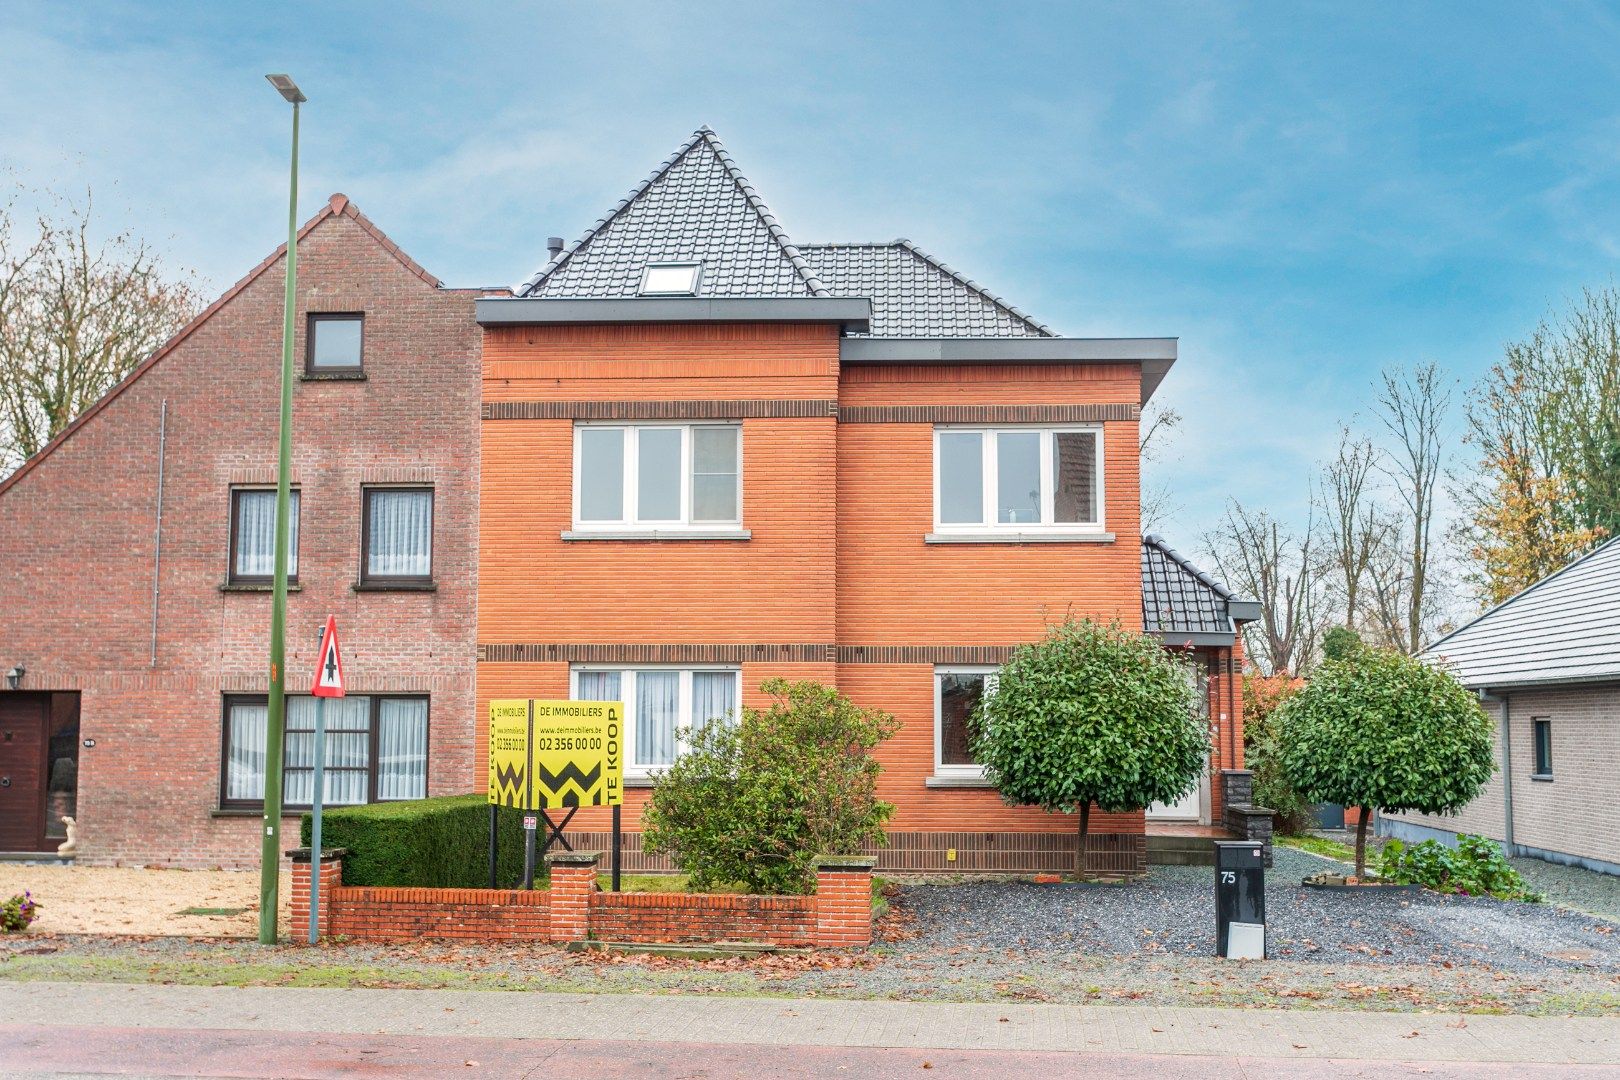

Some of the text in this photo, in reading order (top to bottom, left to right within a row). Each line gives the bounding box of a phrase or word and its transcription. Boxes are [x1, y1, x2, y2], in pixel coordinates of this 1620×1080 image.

[540, 707, 603, 717] DE IMMOBILIERS
[540, 726, 602, 734] www.deimmobiliers.be
[540, 737, 601, 750] 02 356 00 00
[607, 708, 618, 805] TE KOOP
[1221, 871, 1235, 883] 75
